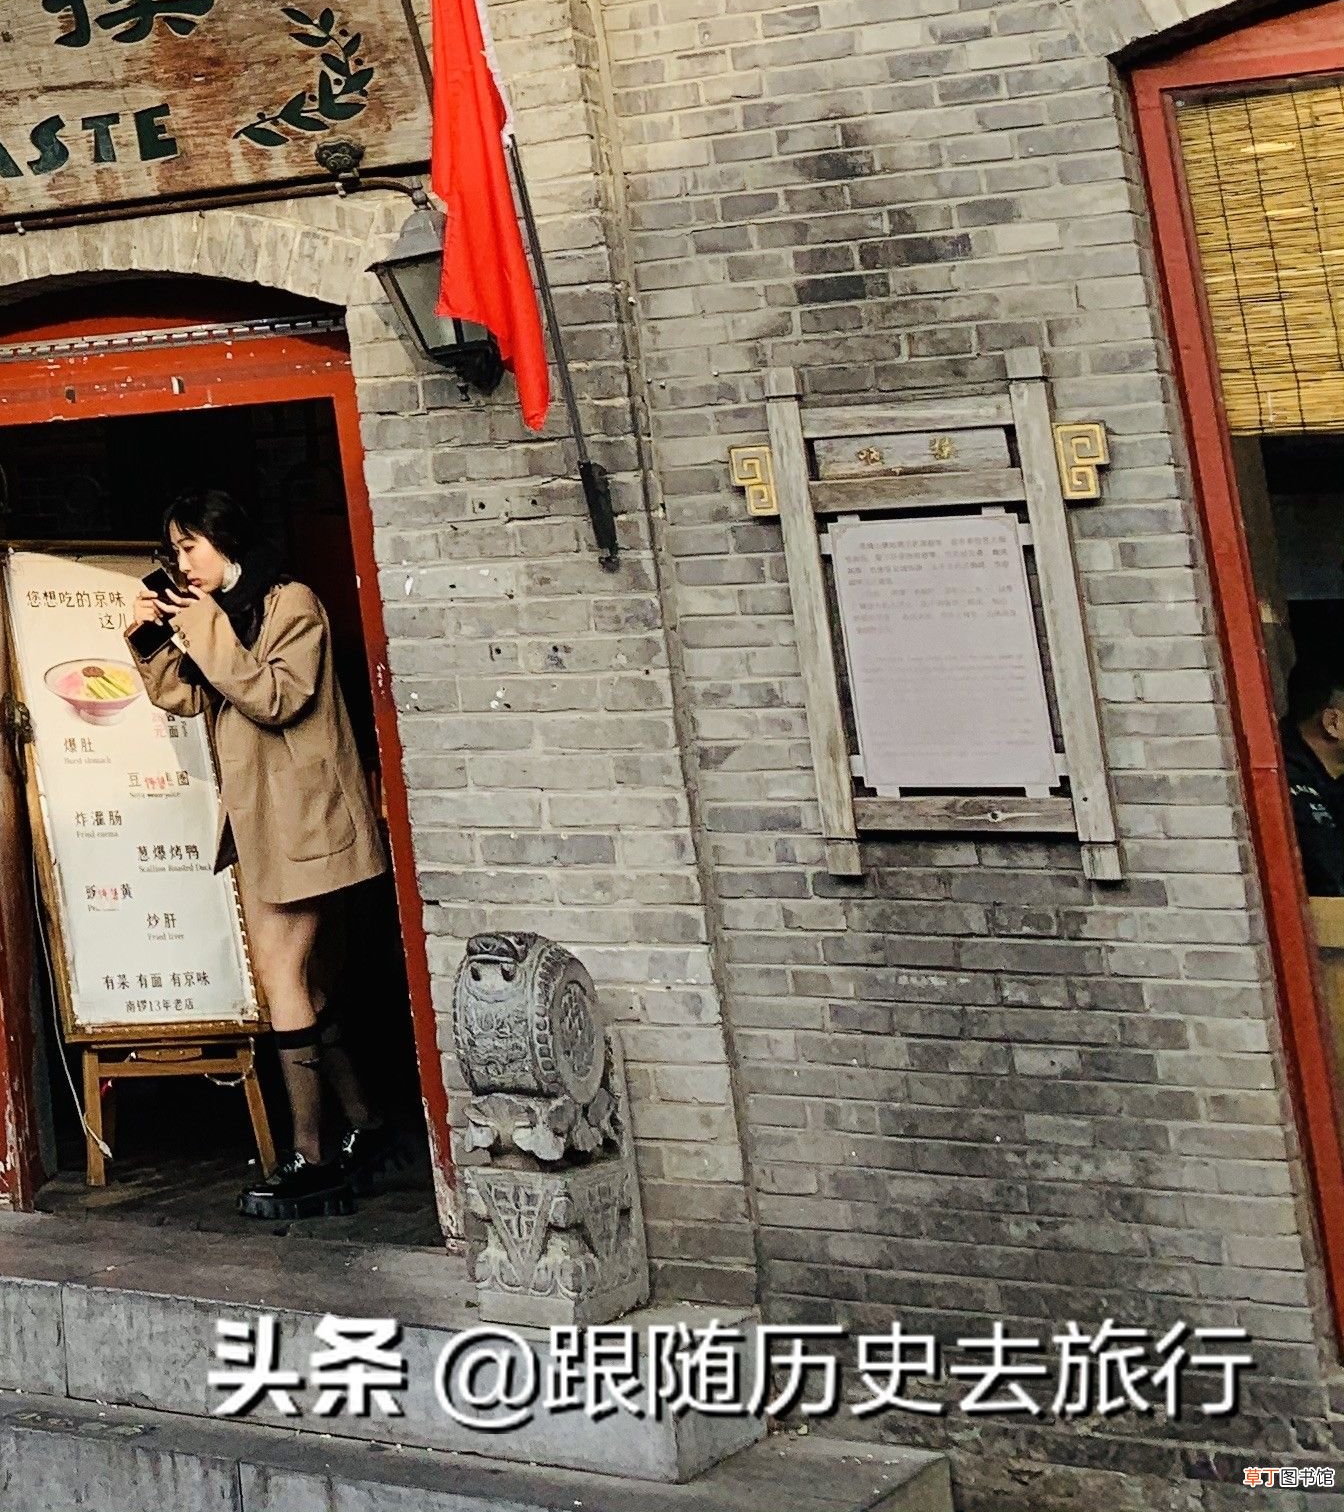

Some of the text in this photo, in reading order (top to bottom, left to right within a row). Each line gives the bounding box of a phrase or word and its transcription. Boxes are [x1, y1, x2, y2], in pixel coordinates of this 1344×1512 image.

[26, 590, 127, 608] 您想吃的京味
